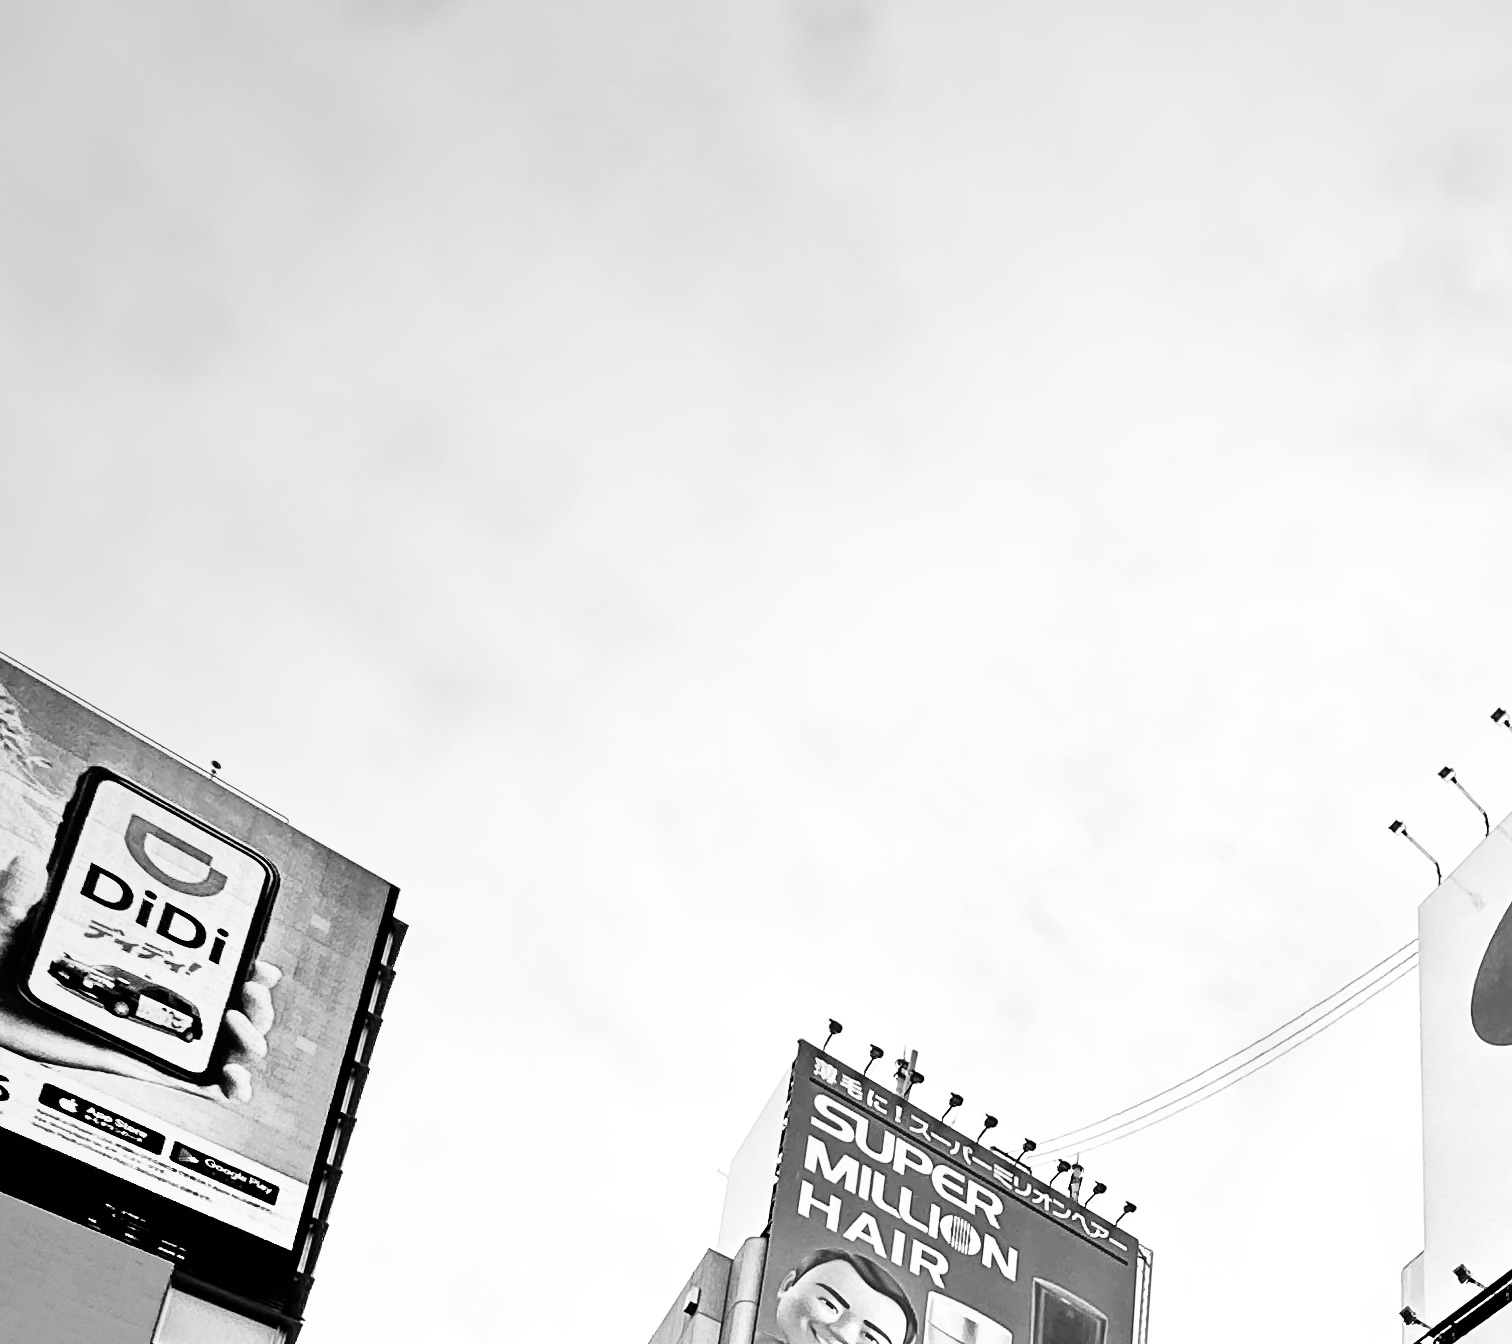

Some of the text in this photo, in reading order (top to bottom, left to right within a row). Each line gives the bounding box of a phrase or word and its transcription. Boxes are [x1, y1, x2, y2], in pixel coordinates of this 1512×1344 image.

[80, 862, 229, 965] DiDi
[204, 1158, 273, 1194] Google Play
[804, 1134, 1018, 1283] MILLION
[810, 1093, 1004, 1229] SUPER
[797, 1180, 949, 1289] HAIR
